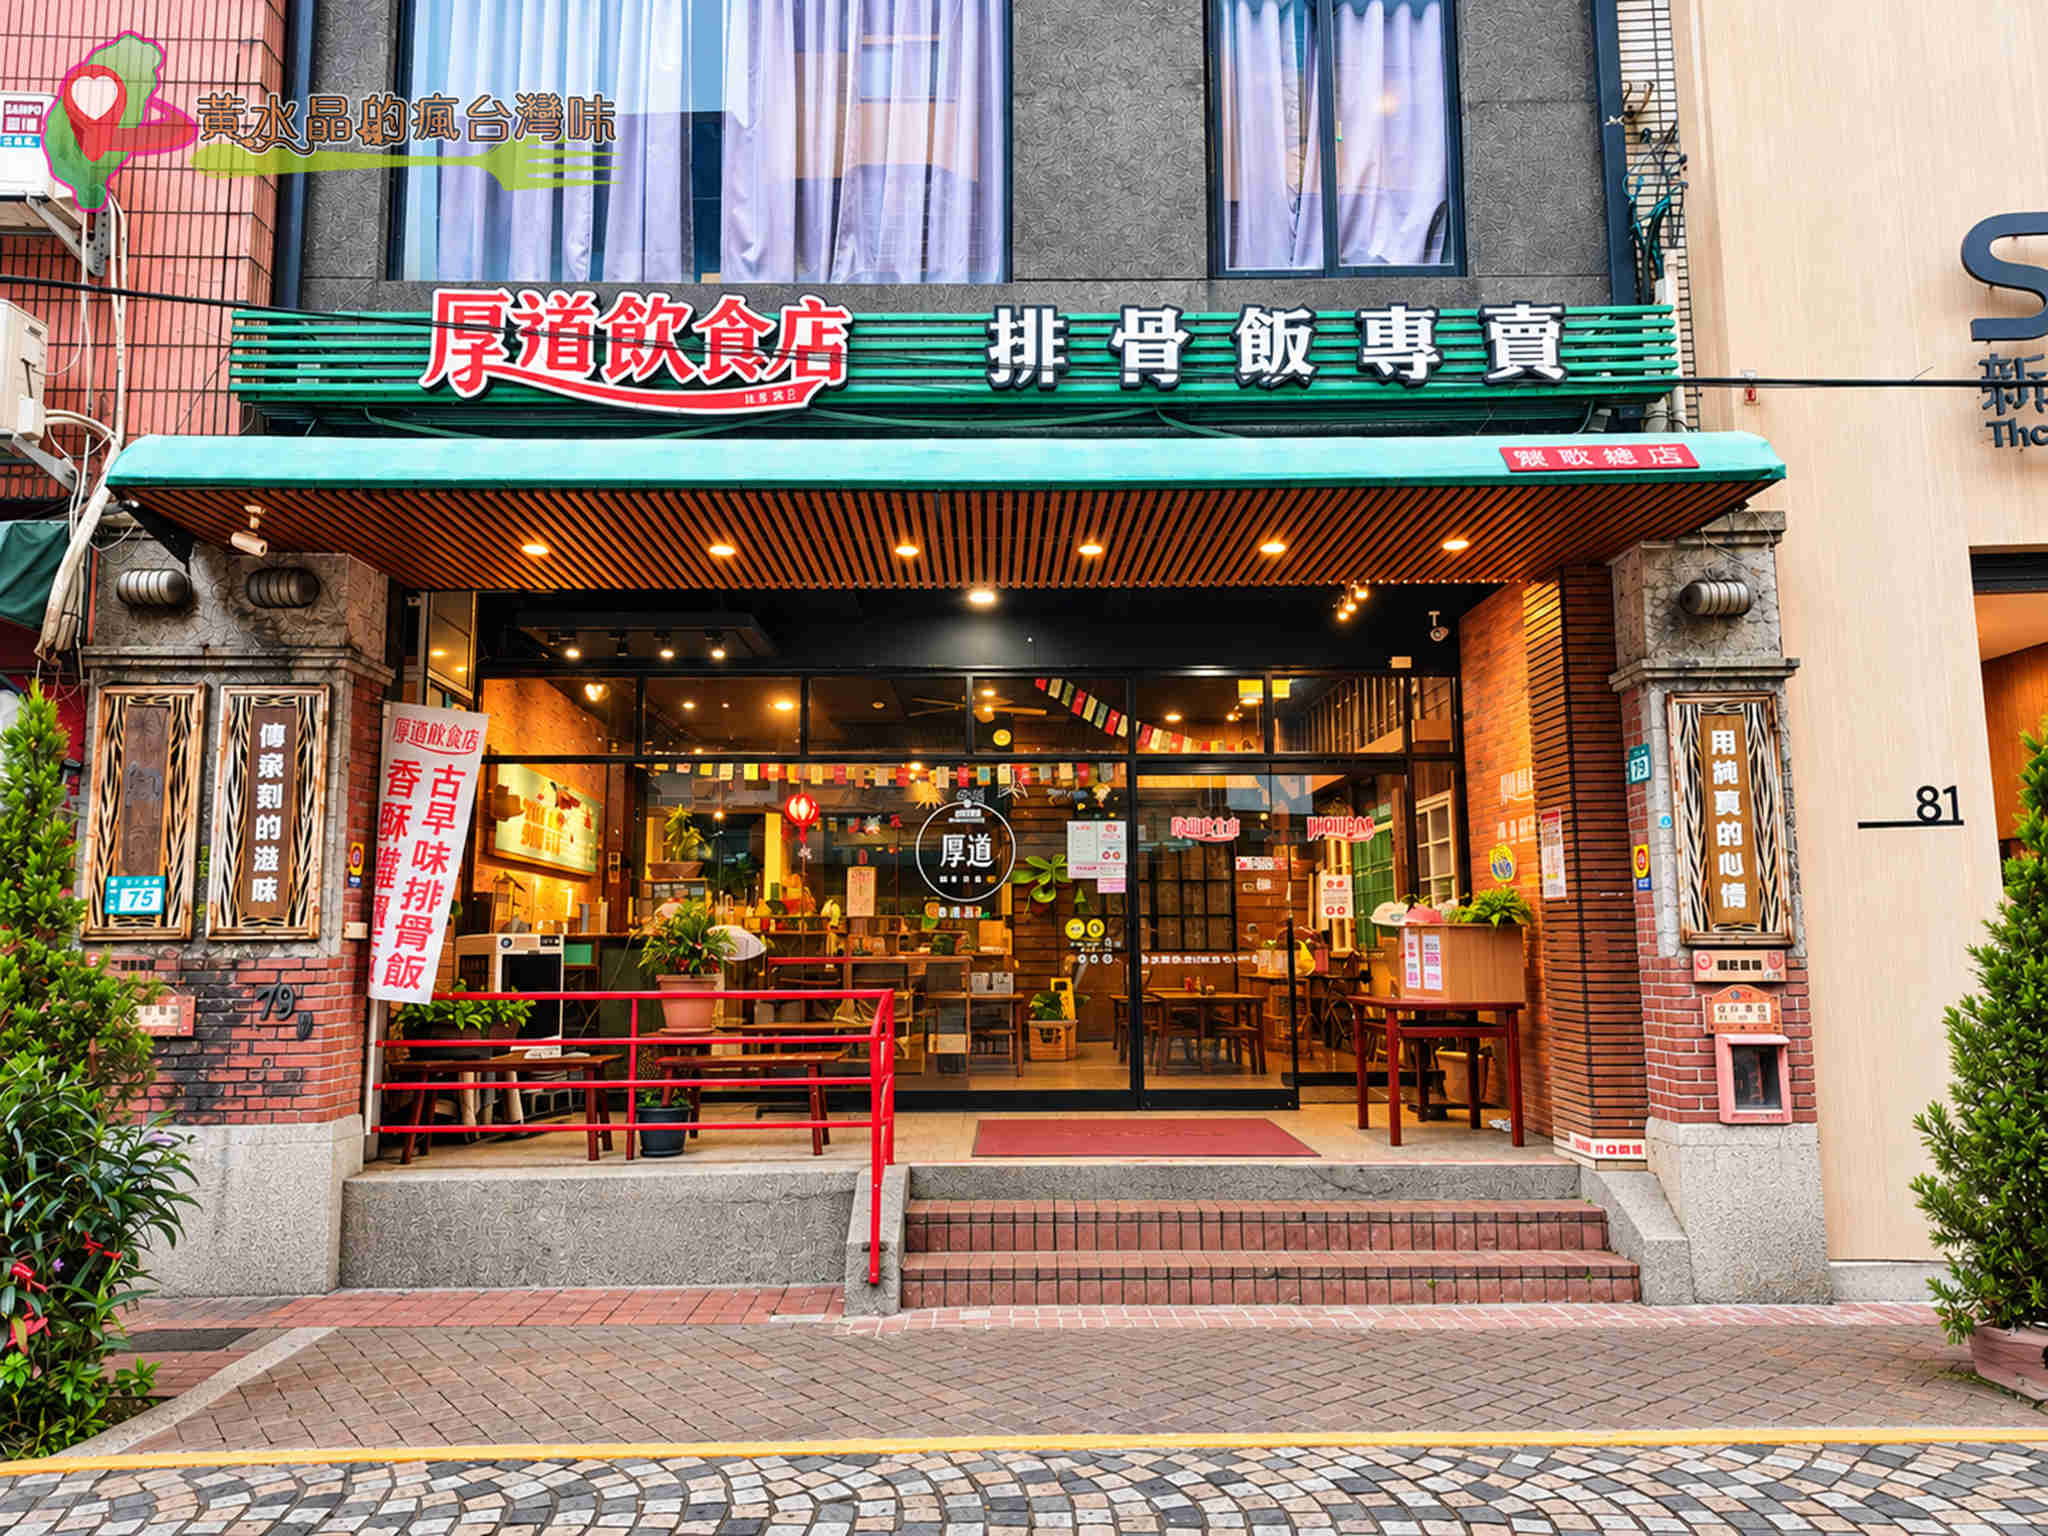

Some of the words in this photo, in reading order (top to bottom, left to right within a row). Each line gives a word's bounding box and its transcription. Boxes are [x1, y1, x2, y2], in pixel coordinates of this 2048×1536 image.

[419, 288, 852, 397] 厚道飲食店
[984, 303, 1568, 388] 排骨飯專賣
[392, 717, 480, 753] 厚道飲食店
[1916, 785, 1959, 821] 81
[940, 832, 993, 868] 厚道
[382, 763, 467, 991] 古早味排骨飯
[128, 889, 154, 908] 75
[256, 984, 296, 1021] 79
